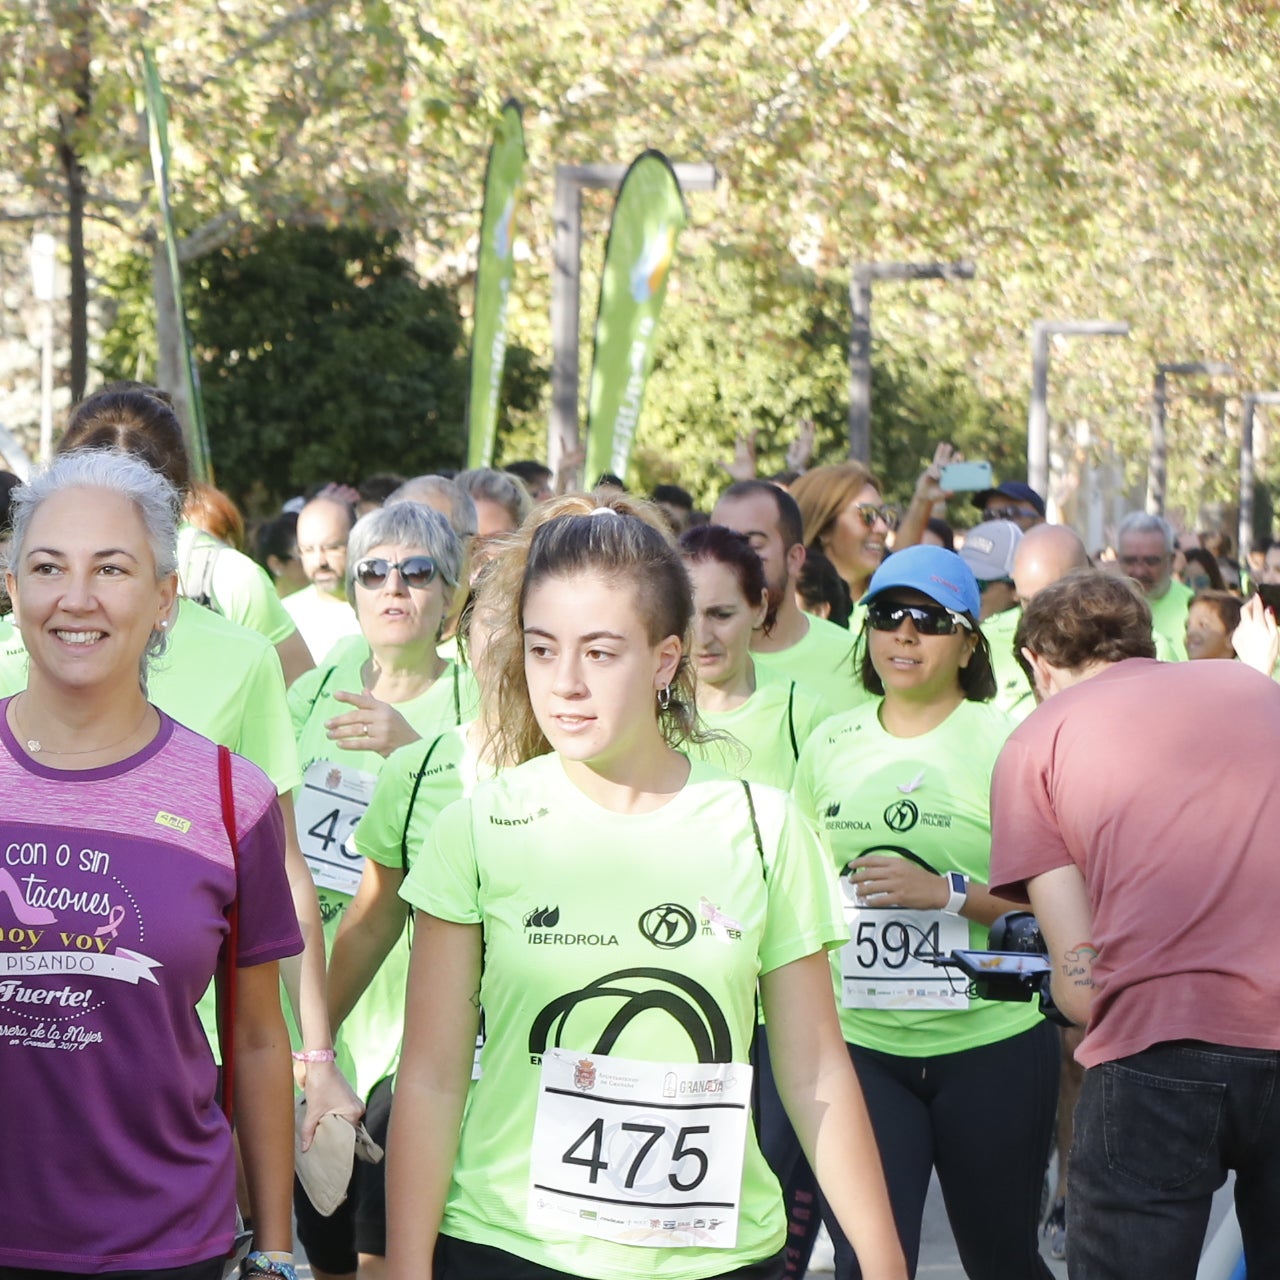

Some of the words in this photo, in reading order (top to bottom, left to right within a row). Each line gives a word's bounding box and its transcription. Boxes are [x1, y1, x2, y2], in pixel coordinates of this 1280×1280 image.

[6, 646, 25, 656] lua
[489, 814, 535, 827] luanvi
[20, 873, 111, 916] tacones
[527, 932, 620, 946] IBERDROLA
[855, 920, 946, 969] 594
[6, 955, 95, 972] PISANDO
[29, 1022, 45, 1039] de
[47, 1023, 62, 1041] la
[63, 1025, 103, 1051] Mujer
[57, 1041, 80, 1052] 2017
[561, 1117, 710, 1192] 475
